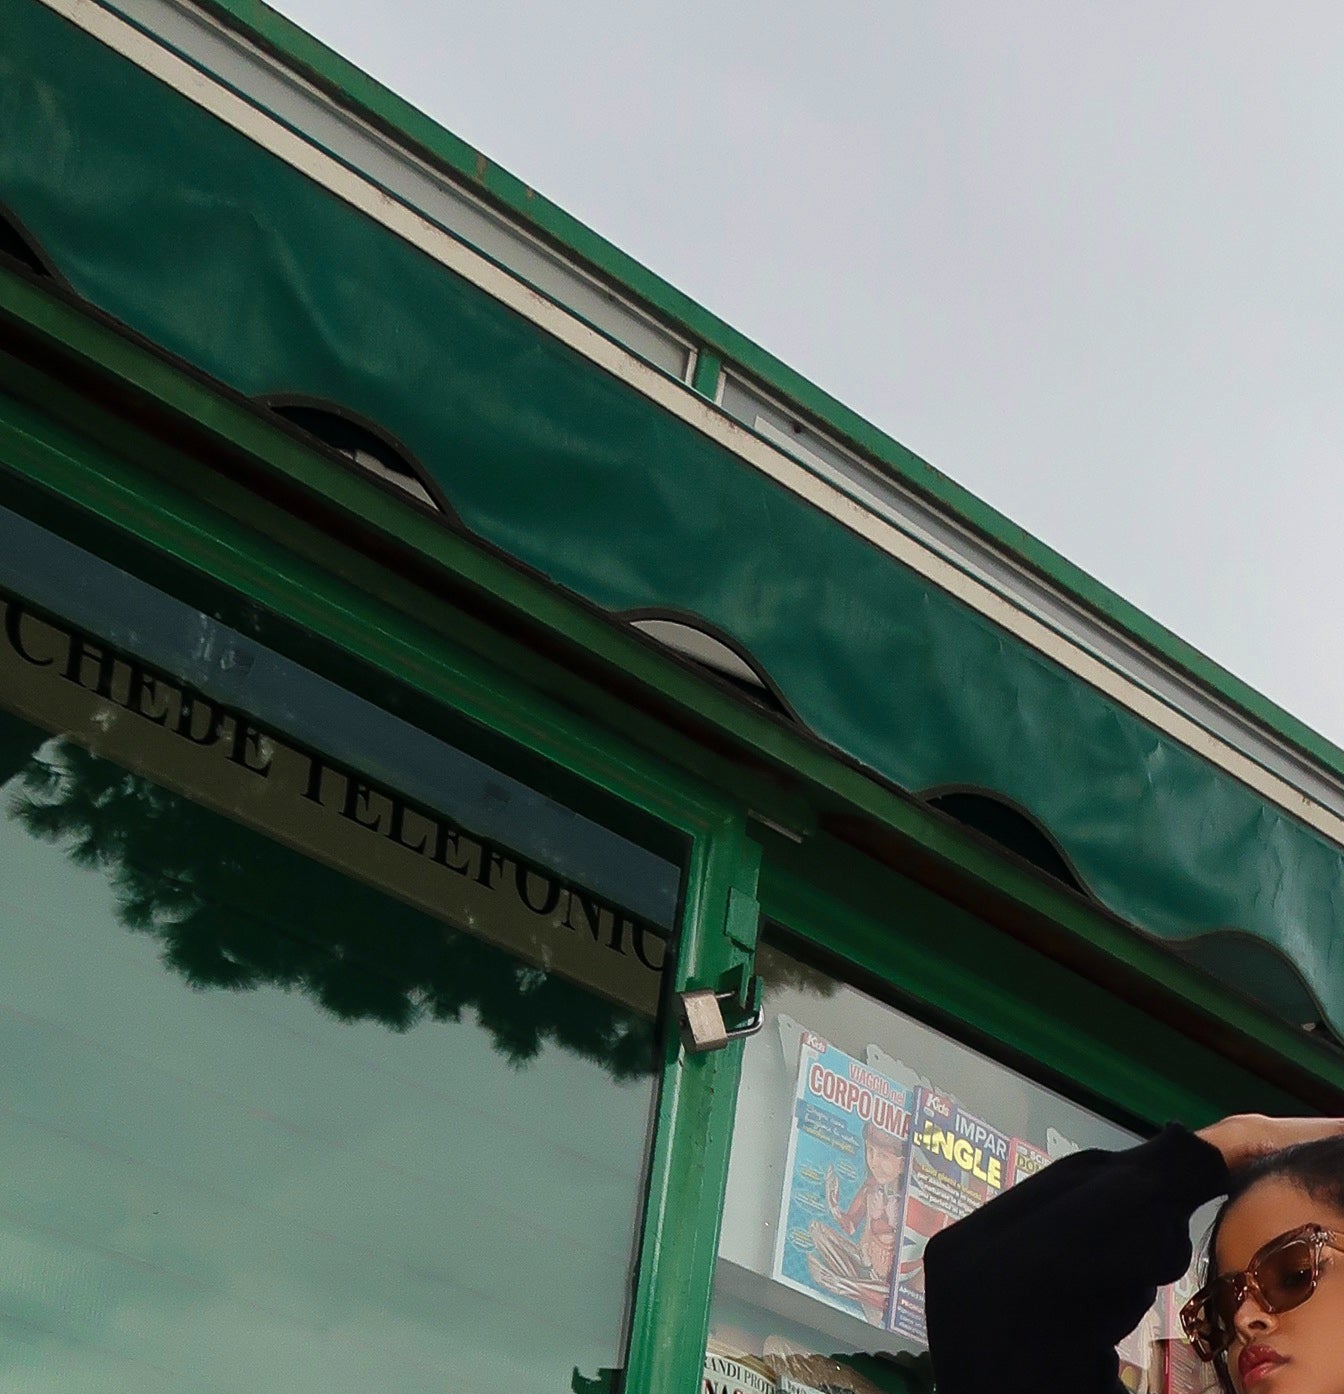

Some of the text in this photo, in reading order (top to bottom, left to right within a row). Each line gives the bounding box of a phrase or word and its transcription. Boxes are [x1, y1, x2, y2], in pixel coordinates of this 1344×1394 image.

[806, 1033, 827, 1054] Kids
[809, 1063, 872, 1121] CORPO
[848, 1063, 890, 1097] VIAGGIO
[926, 1092, 951, 1117] Kids
[955, 1113, 1008, 1160] IMPAR
